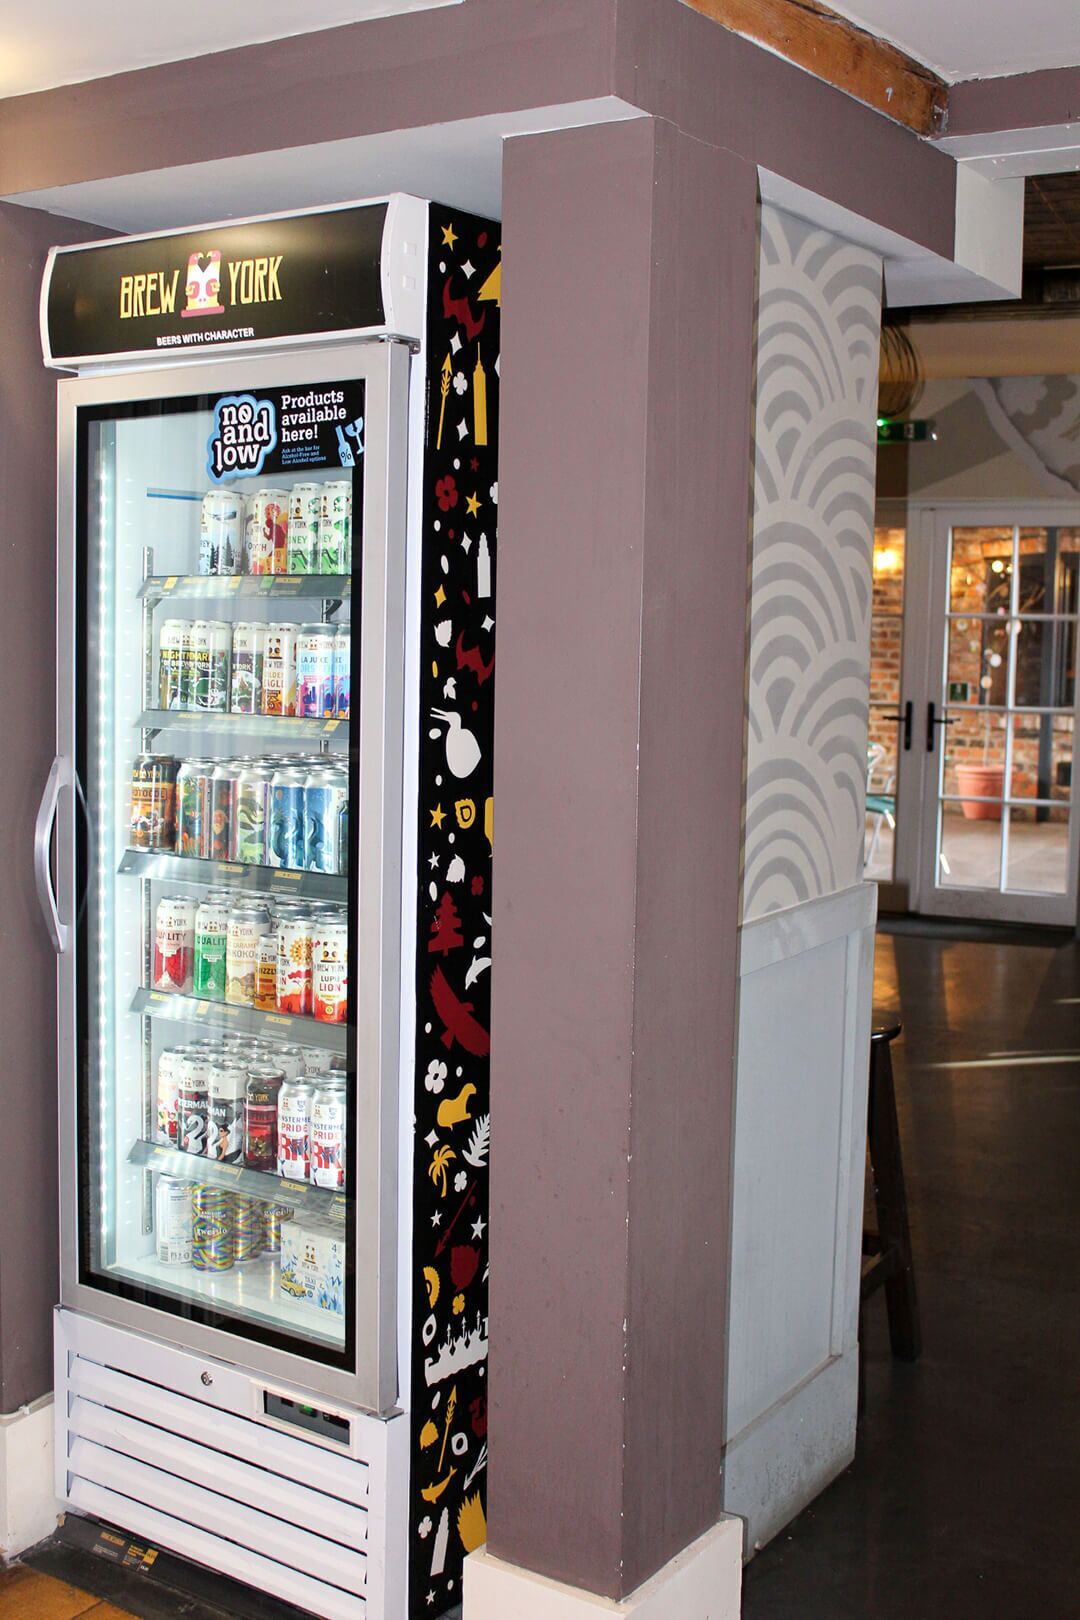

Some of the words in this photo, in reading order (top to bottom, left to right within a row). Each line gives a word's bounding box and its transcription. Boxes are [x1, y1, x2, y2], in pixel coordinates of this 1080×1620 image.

[119, 269, 180, 319] BREW
[228, 255, 284, 306] YORK
[156, 335, 182, 346] BEERS
[182, 332, 204, 344] WITH
[204, 327, 255, 342] CHARACTER
[281, 390, 344, 410] Products
[222, 404, 253, 426] no
[281, 407, 347, 426] available
[223, 410, 270, 445] and
[281, 424, 319, 443] here!
[214, 440, 260, 473] low
